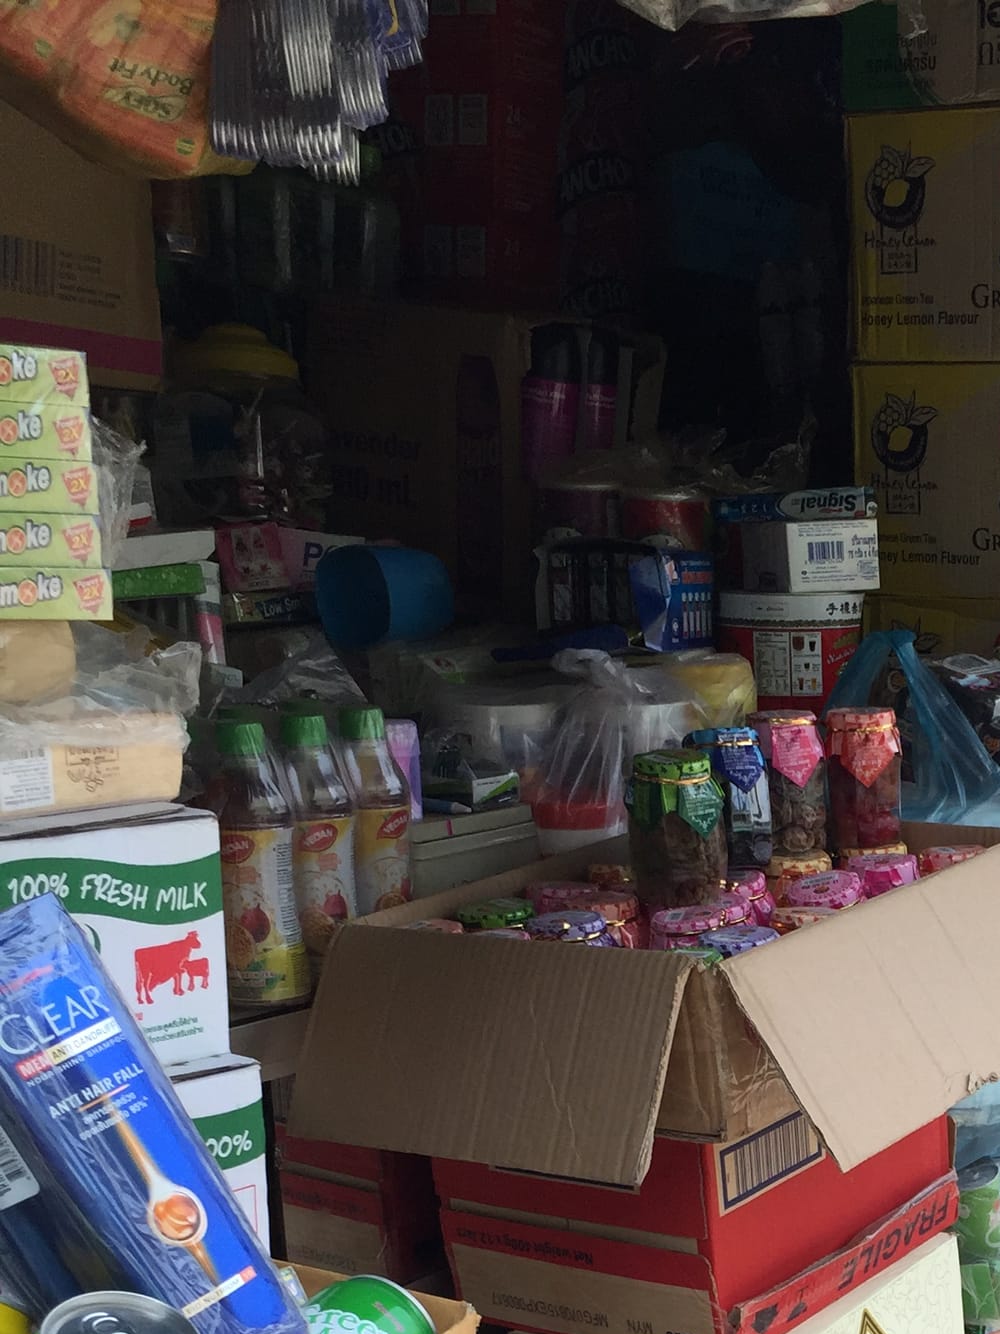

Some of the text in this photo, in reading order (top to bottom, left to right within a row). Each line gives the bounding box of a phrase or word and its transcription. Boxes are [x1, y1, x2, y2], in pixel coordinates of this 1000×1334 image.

[141, 66, 195, 97] Body
[896, 311, 935, 327] Lemon
[937, 311, 980, 327] Flavour
[800, 493, 857, 513] Signal
[902, 550, 939, 564] Lemon
[940, 550, 982, 567] Flavour
[7, 872, 208, 913] 100% FRESH MILK
[0, 984, 111, 1055] CLEAR
[19, 1055, 52, 1077] MEN
[49, 1094, 84, 1120] ANTI
[81, 1076, 115, 1101] HAIR
[111, 1062, 144, 1085] FALL
[203, 1129, 254, 1161] 00%
[838, 1190, 951, 1293] FRAGILE
